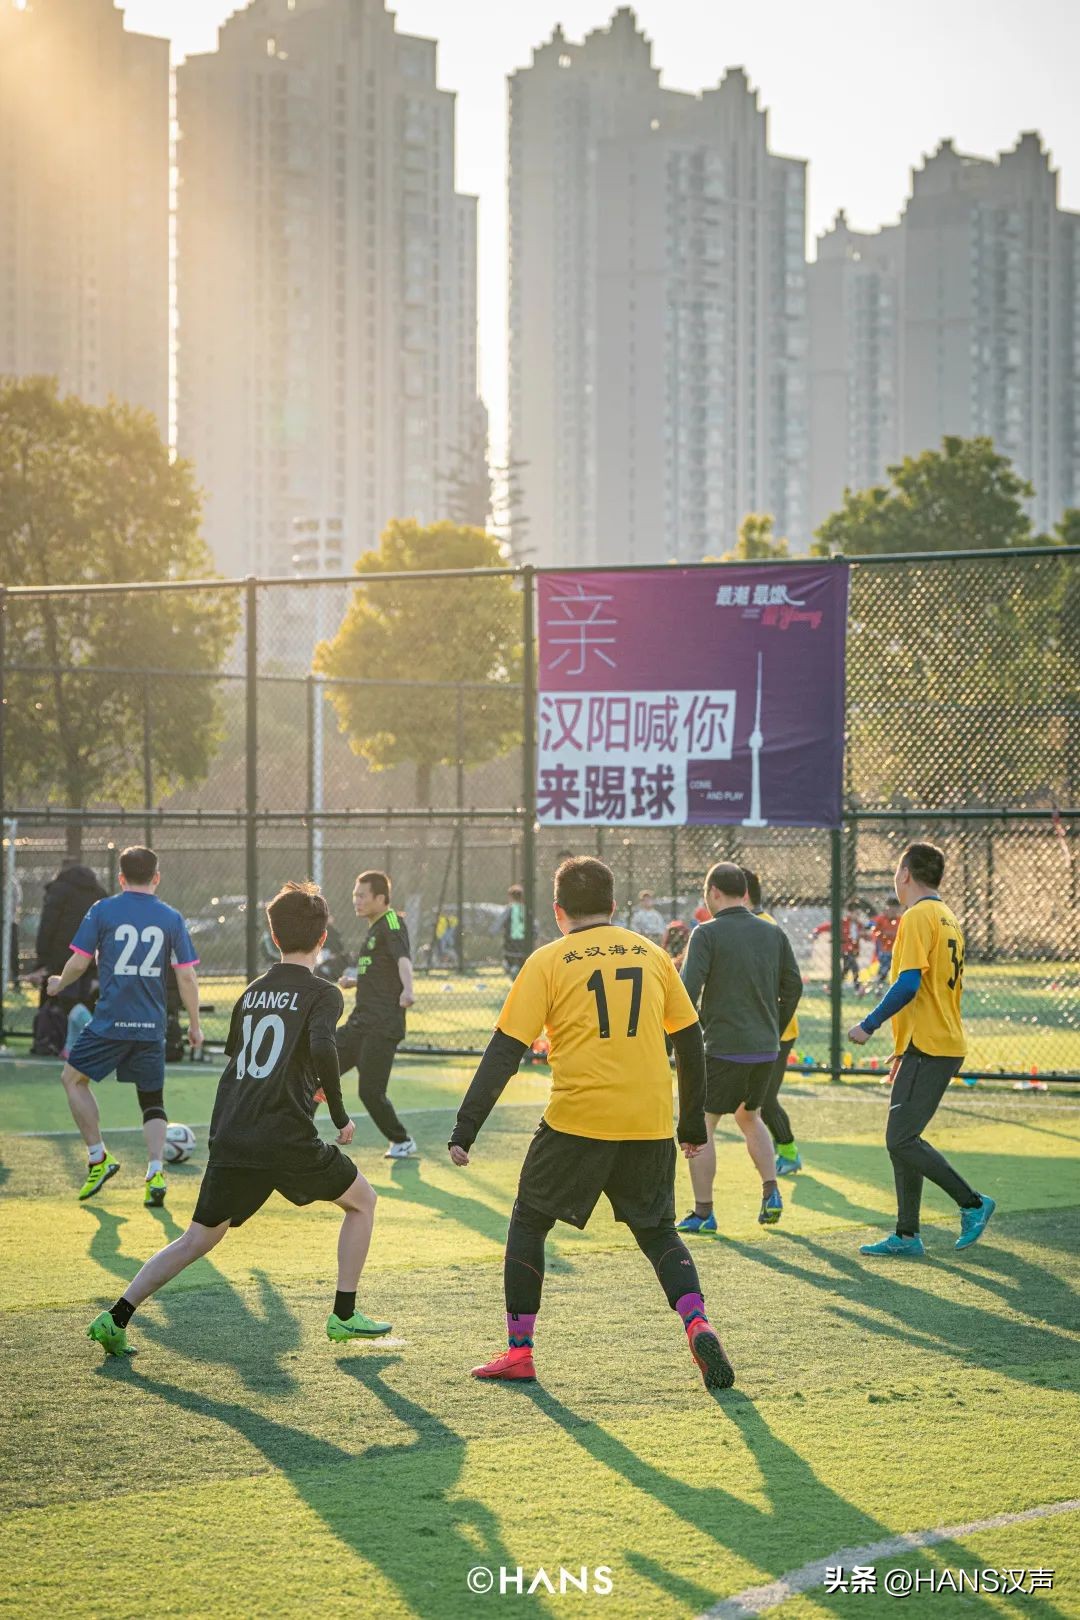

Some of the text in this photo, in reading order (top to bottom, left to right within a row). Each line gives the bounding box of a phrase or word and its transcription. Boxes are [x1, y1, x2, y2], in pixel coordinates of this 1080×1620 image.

[547, 584, 617, 675] 亲
[541, 695, 729, 752] 汉阳喊你
[536, 763, 676, 820] 来踢球
[114, 924, 164, 977] 22
[587, 967, 643, 1038] 17
[236, 1014, 285, 1080] 10
